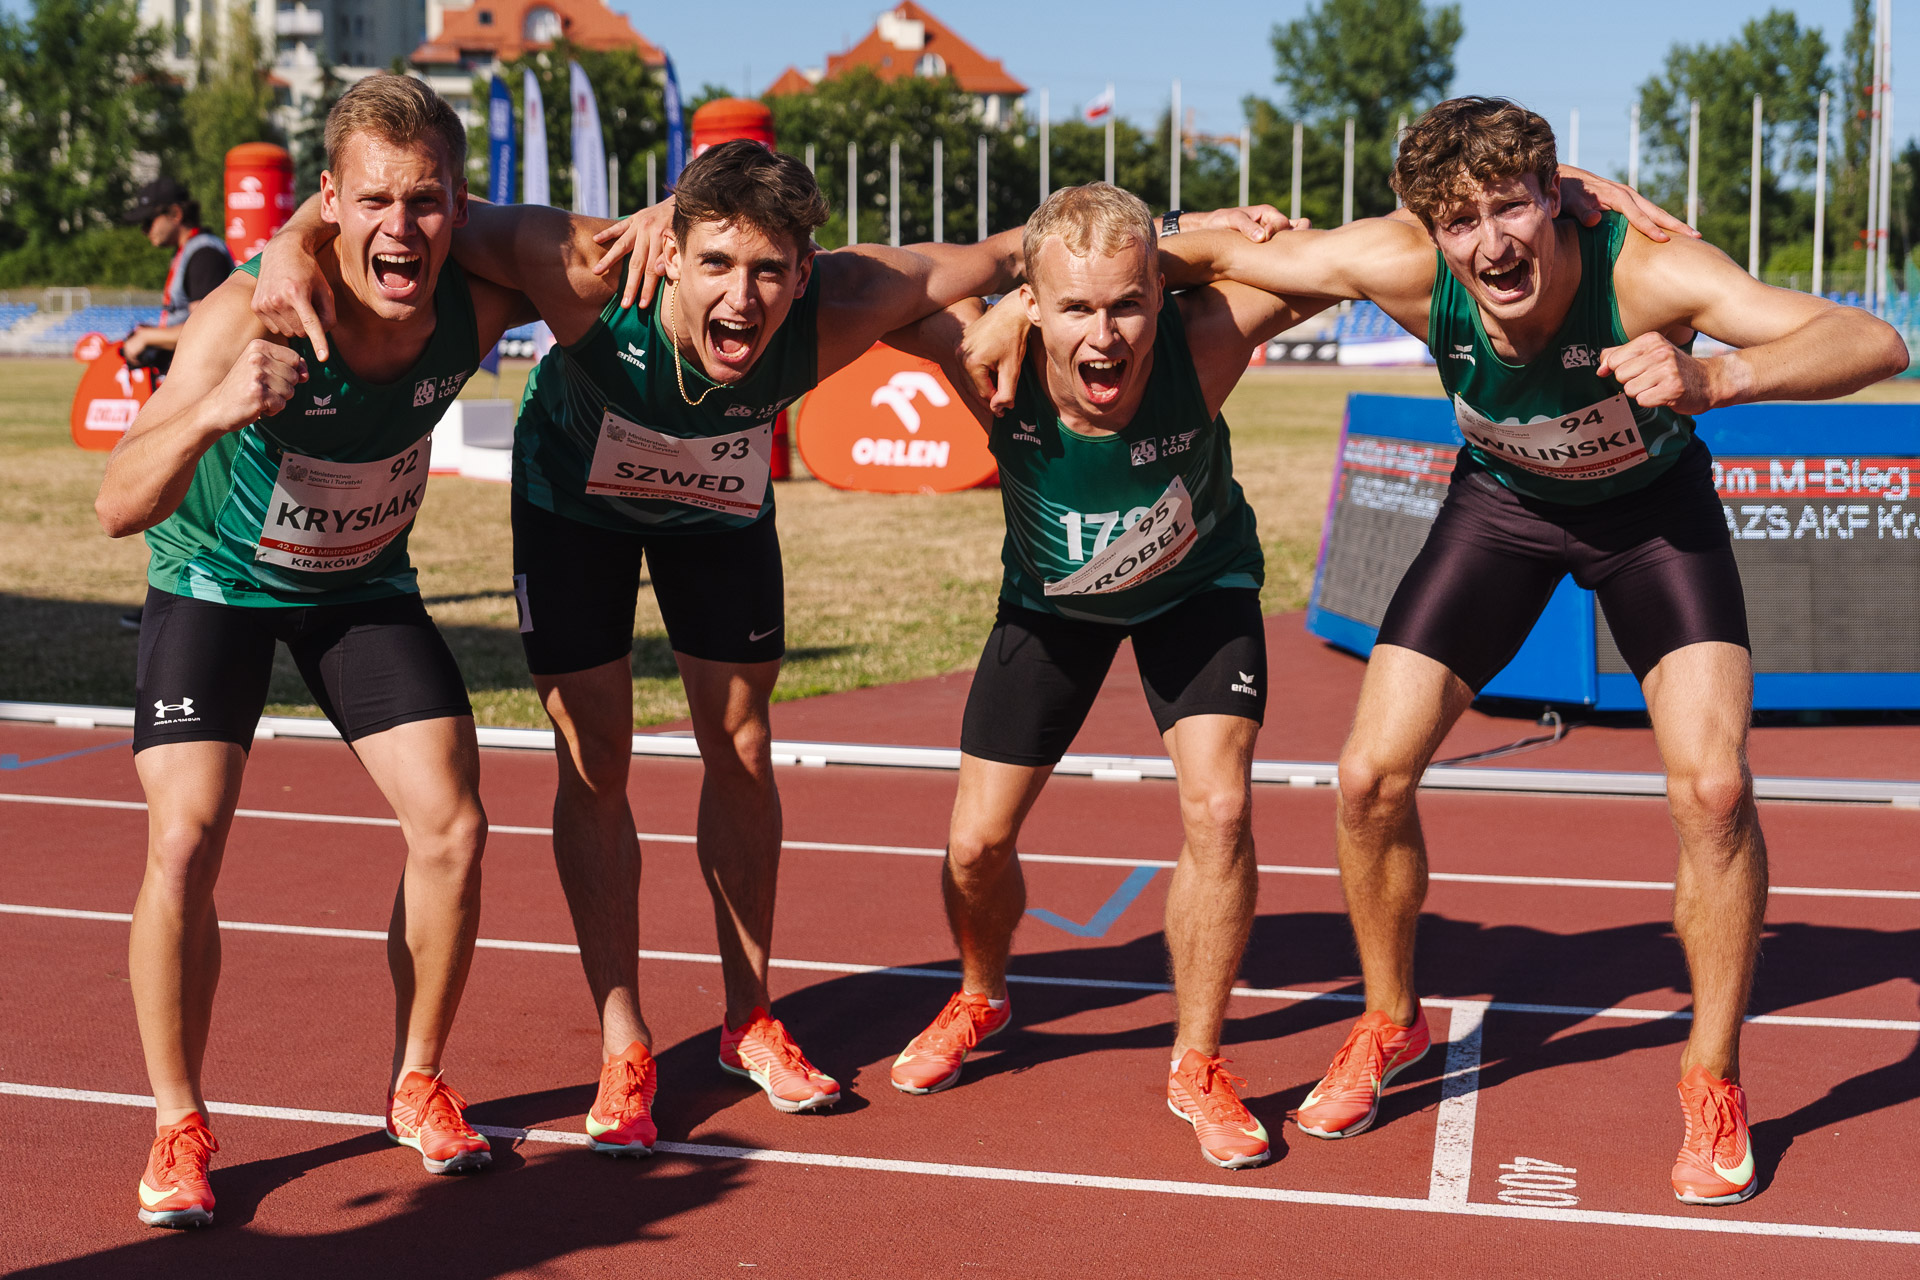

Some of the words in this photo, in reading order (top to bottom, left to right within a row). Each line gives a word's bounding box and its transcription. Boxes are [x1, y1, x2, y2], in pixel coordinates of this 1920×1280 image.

[616, 350, 646, 371] erima
[305, 407, 337, 416] erima
[1560, 408, 1604, 435] 94
[711, 437, 750, 462] 93
[1013, 432, 1042, 446] erima
[851, 437, 950, 468] ORLEN
[389, 449, 419, 483] 92
[614, 461, 745, 493] SZWED
[1578, 466, 1617, 478] 2025
[276, 483, 423, 533] KRYSIAK
[619, 490, 689, 502] KRAKÓW
[690, 498, 727, 511] 2025
[1139, 501, 1170, 537] 95
[1877, 505, 1920, 540] Kr
[276, 542, 291, 551] 42.
[291, 556, 360, 569] KRAKÓW
[1231, 683, 1257, 697] erima
[1498, 1156, 1578, 1207] 400
